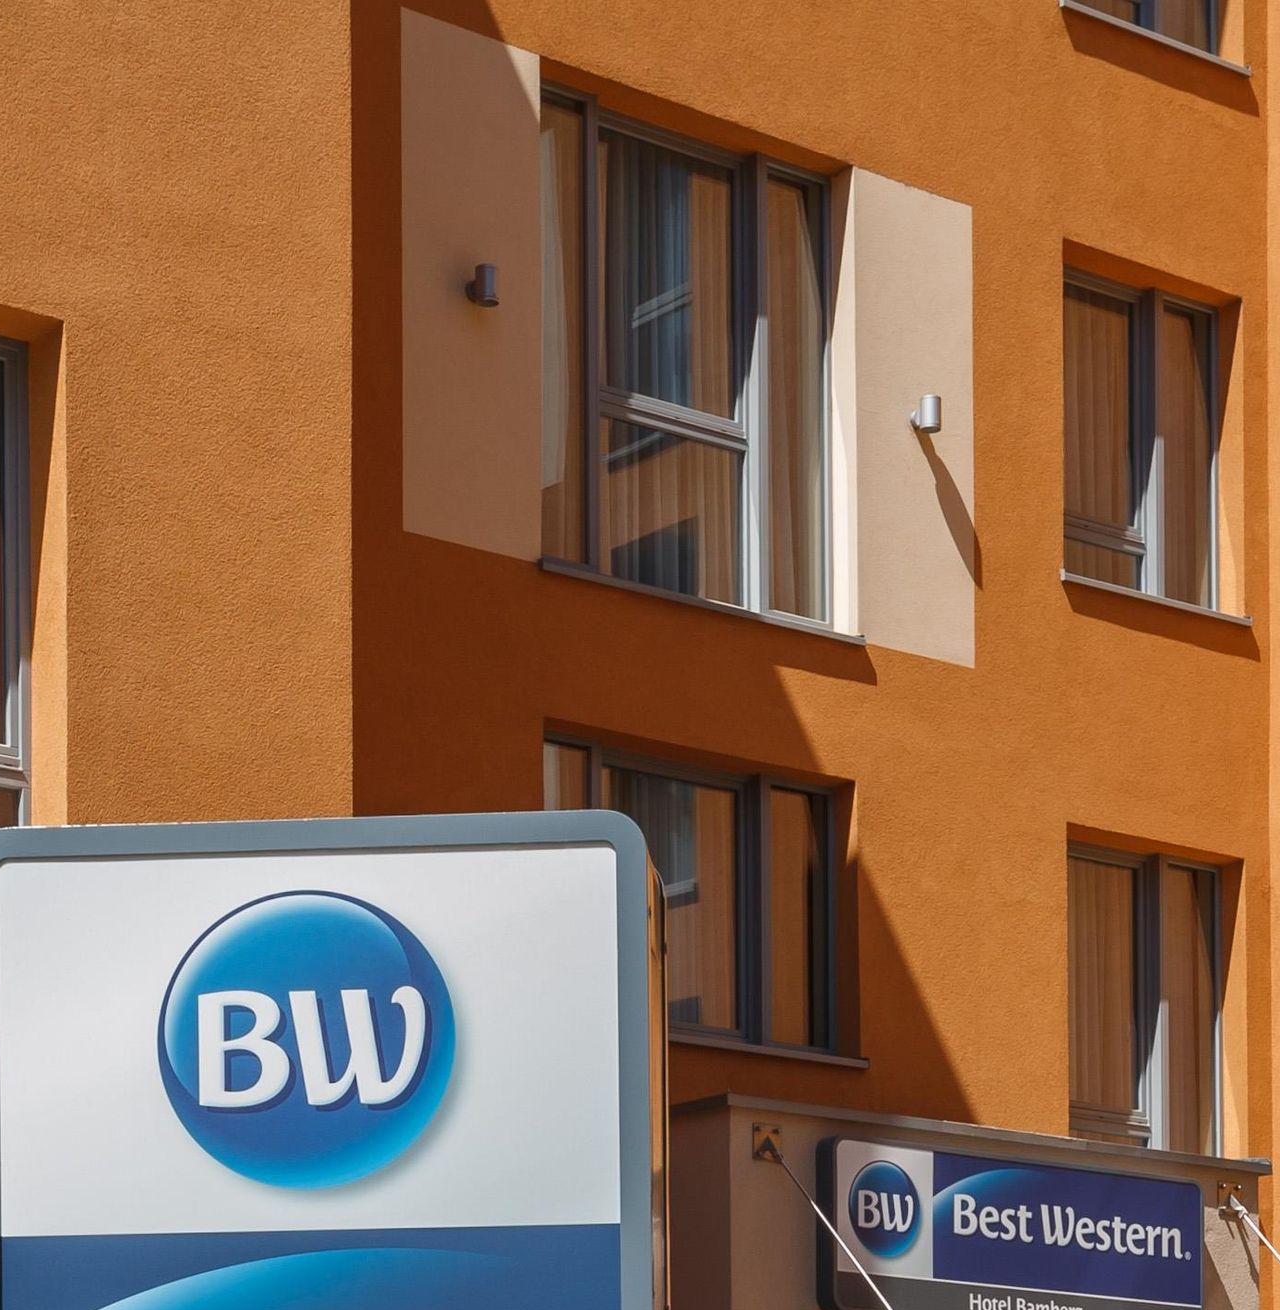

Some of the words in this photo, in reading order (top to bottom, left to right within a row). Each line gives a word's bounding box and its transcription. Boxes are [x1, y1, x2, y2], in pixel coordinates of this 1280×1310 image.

[196, 985, 428, 1110] BW
[857, 1189, 914, 1233] BW
[953, 1193, 1034, 1243] Best
